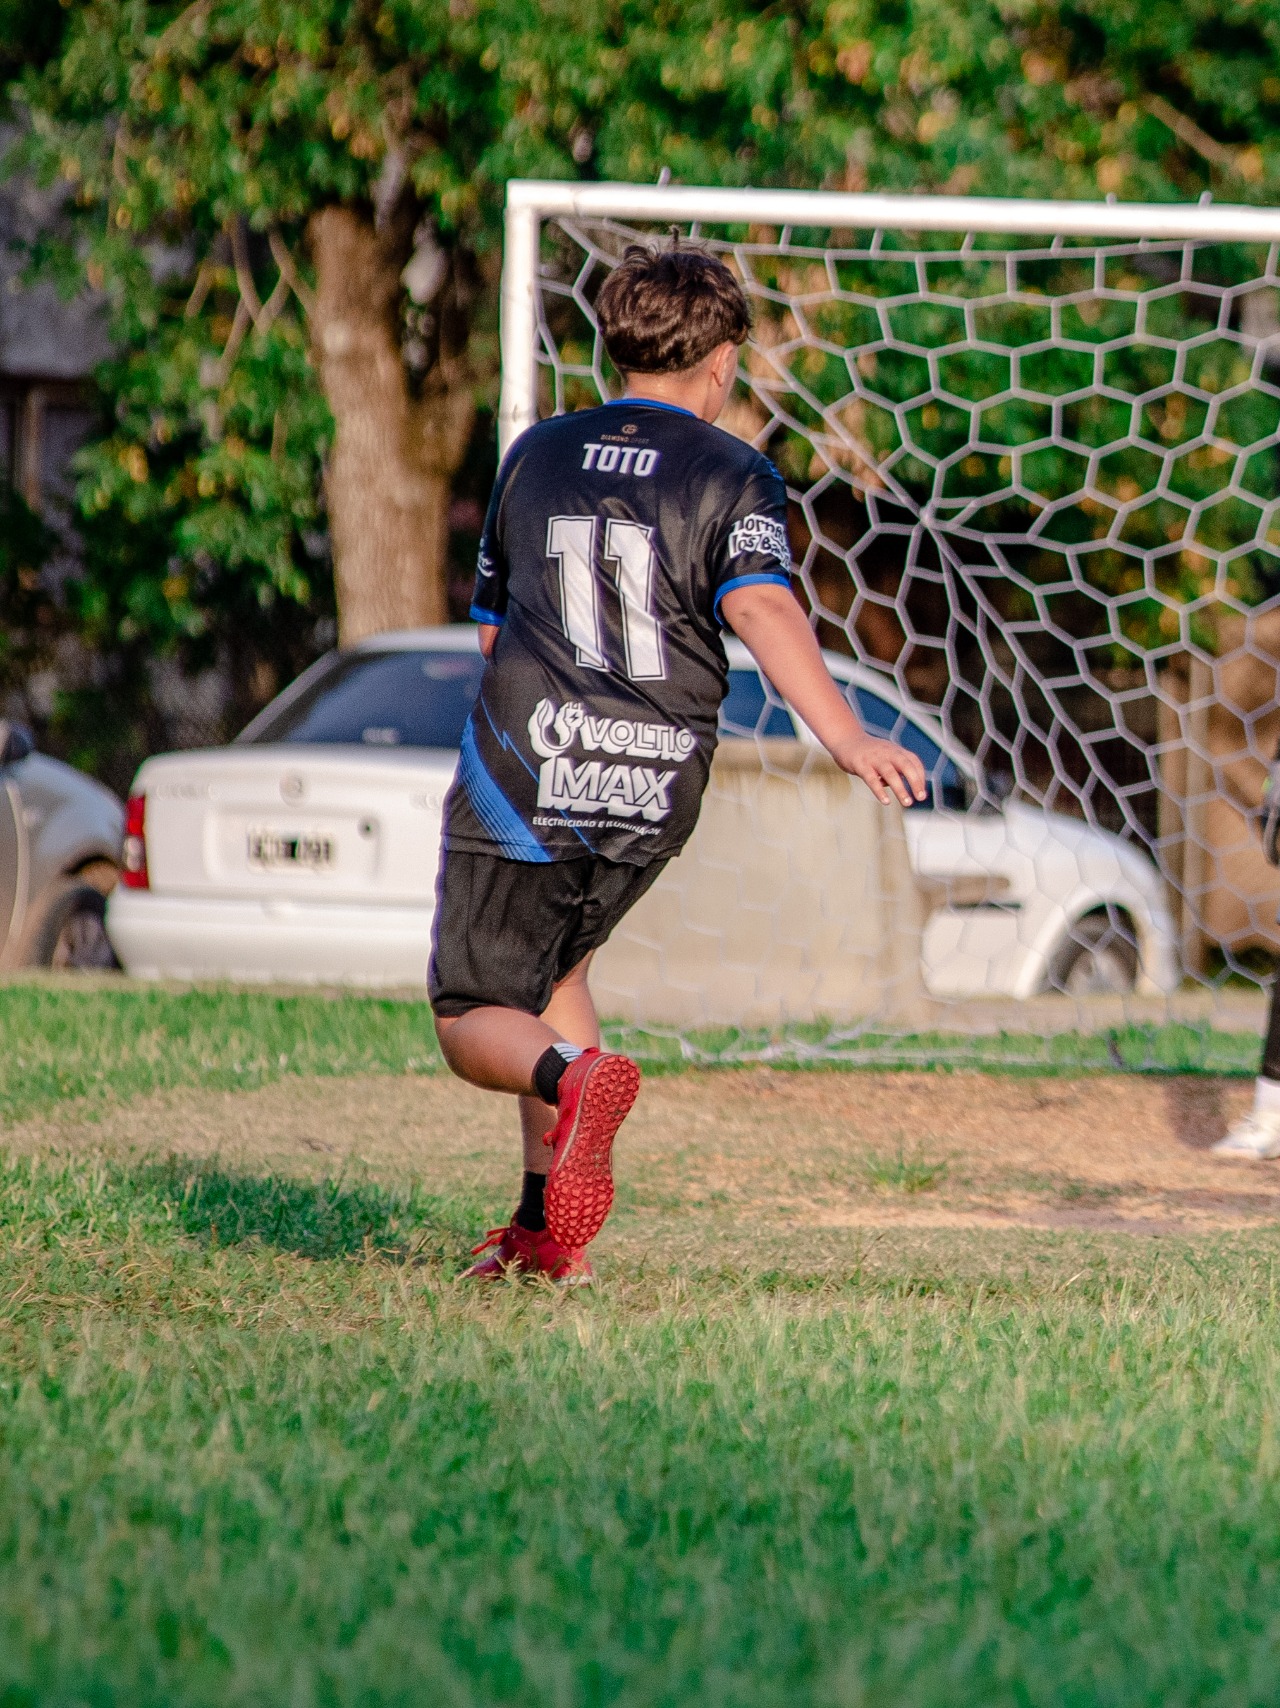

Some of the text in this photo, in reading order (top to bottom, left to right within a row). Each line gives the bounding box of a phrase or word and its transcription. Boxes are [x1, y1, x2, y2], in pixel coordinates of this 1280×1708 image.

[581, 443, 660, 477] TOTO
[546, 515, 667, 681] 11
[580, 715, 698, 762] VOLTIO
[537, 756, 678, 822] MAX
[532, 816, 596, 828] ELECTRICIDAD
